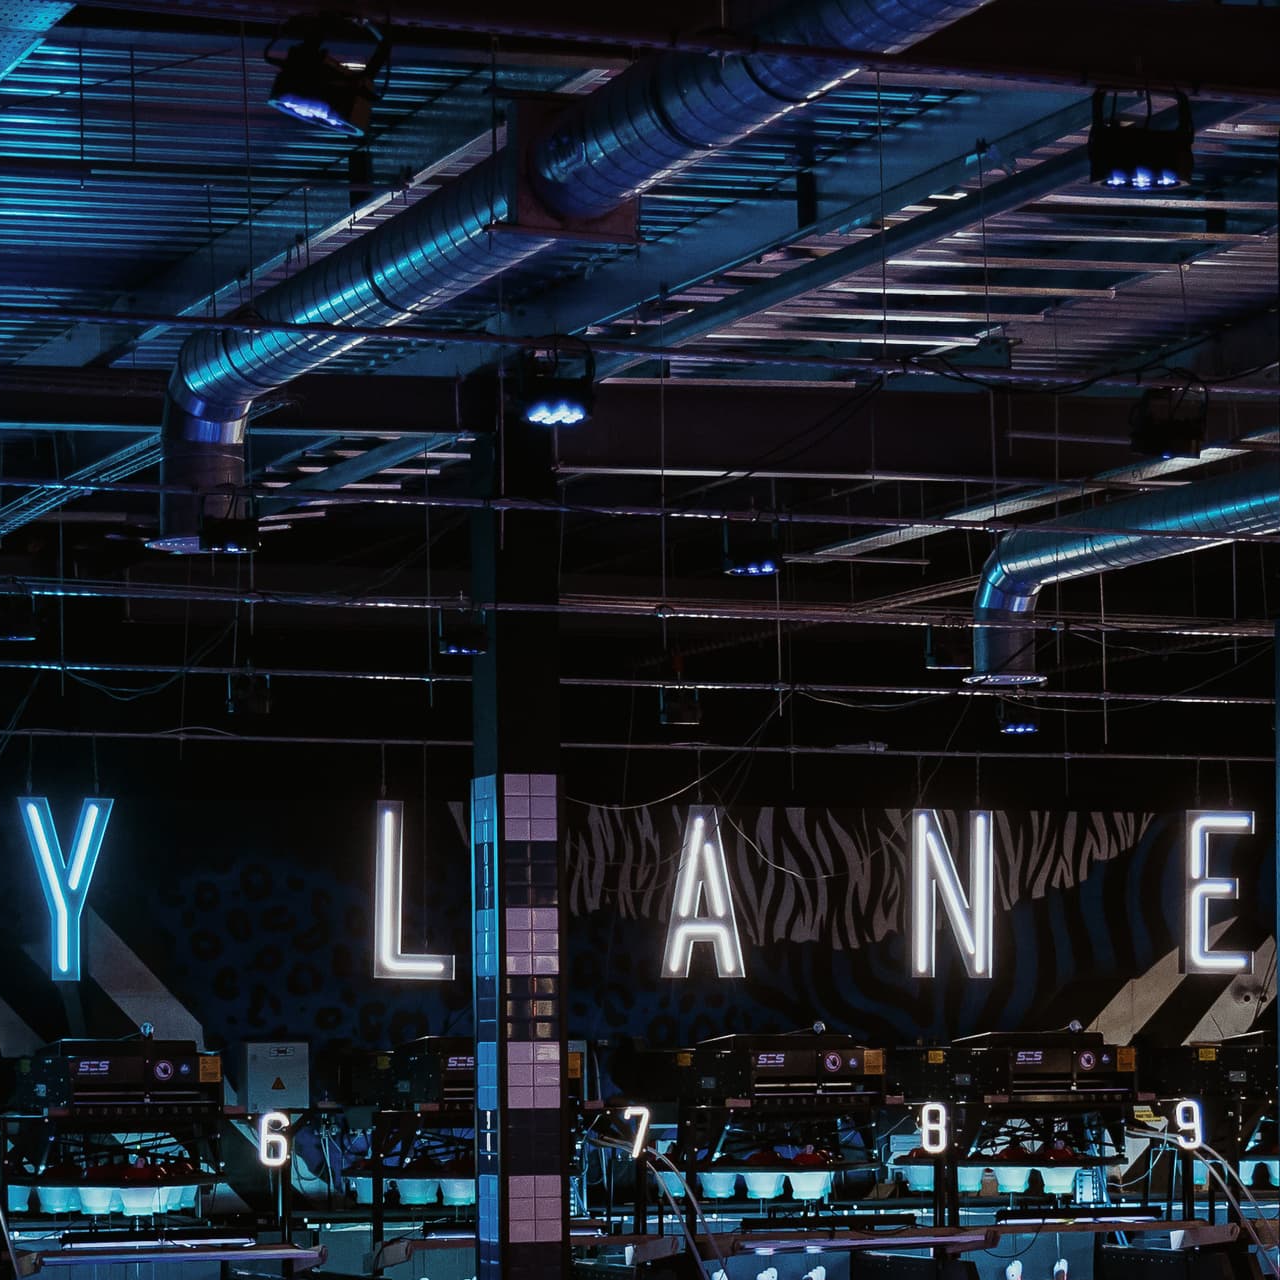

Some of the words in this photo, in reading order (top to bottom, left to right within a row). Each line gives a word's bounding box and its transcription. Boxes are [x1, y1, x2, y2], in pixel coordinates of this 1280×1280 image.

[259, 1112, 290, 1167] 6
[623, 1104, 651, 1159] 7
[920, 1103, 947, 1154] 8
[1176, 1100, 1202, 1150] 9
